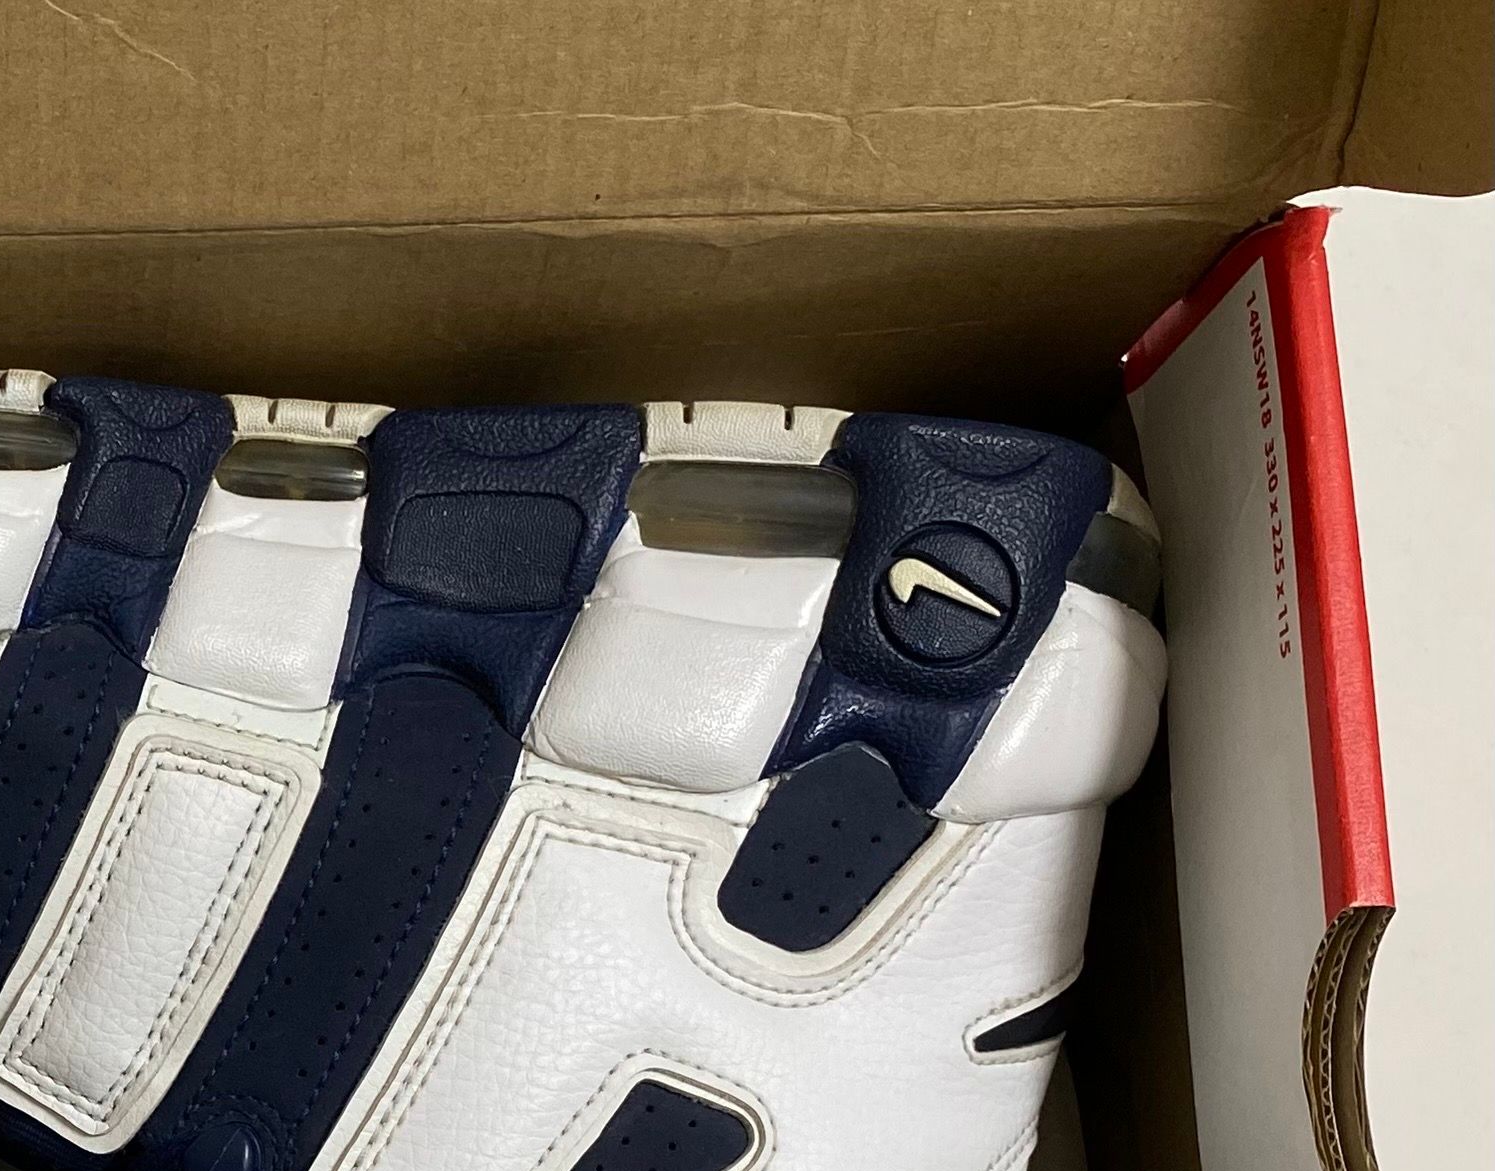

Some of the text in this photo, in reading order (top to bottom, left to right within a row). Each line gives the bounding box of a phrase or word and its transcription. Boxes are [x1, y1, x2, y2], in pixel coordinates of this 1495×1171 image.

[1246, 290, 1291, 659] 14NSW18 330 x 225 x 115
